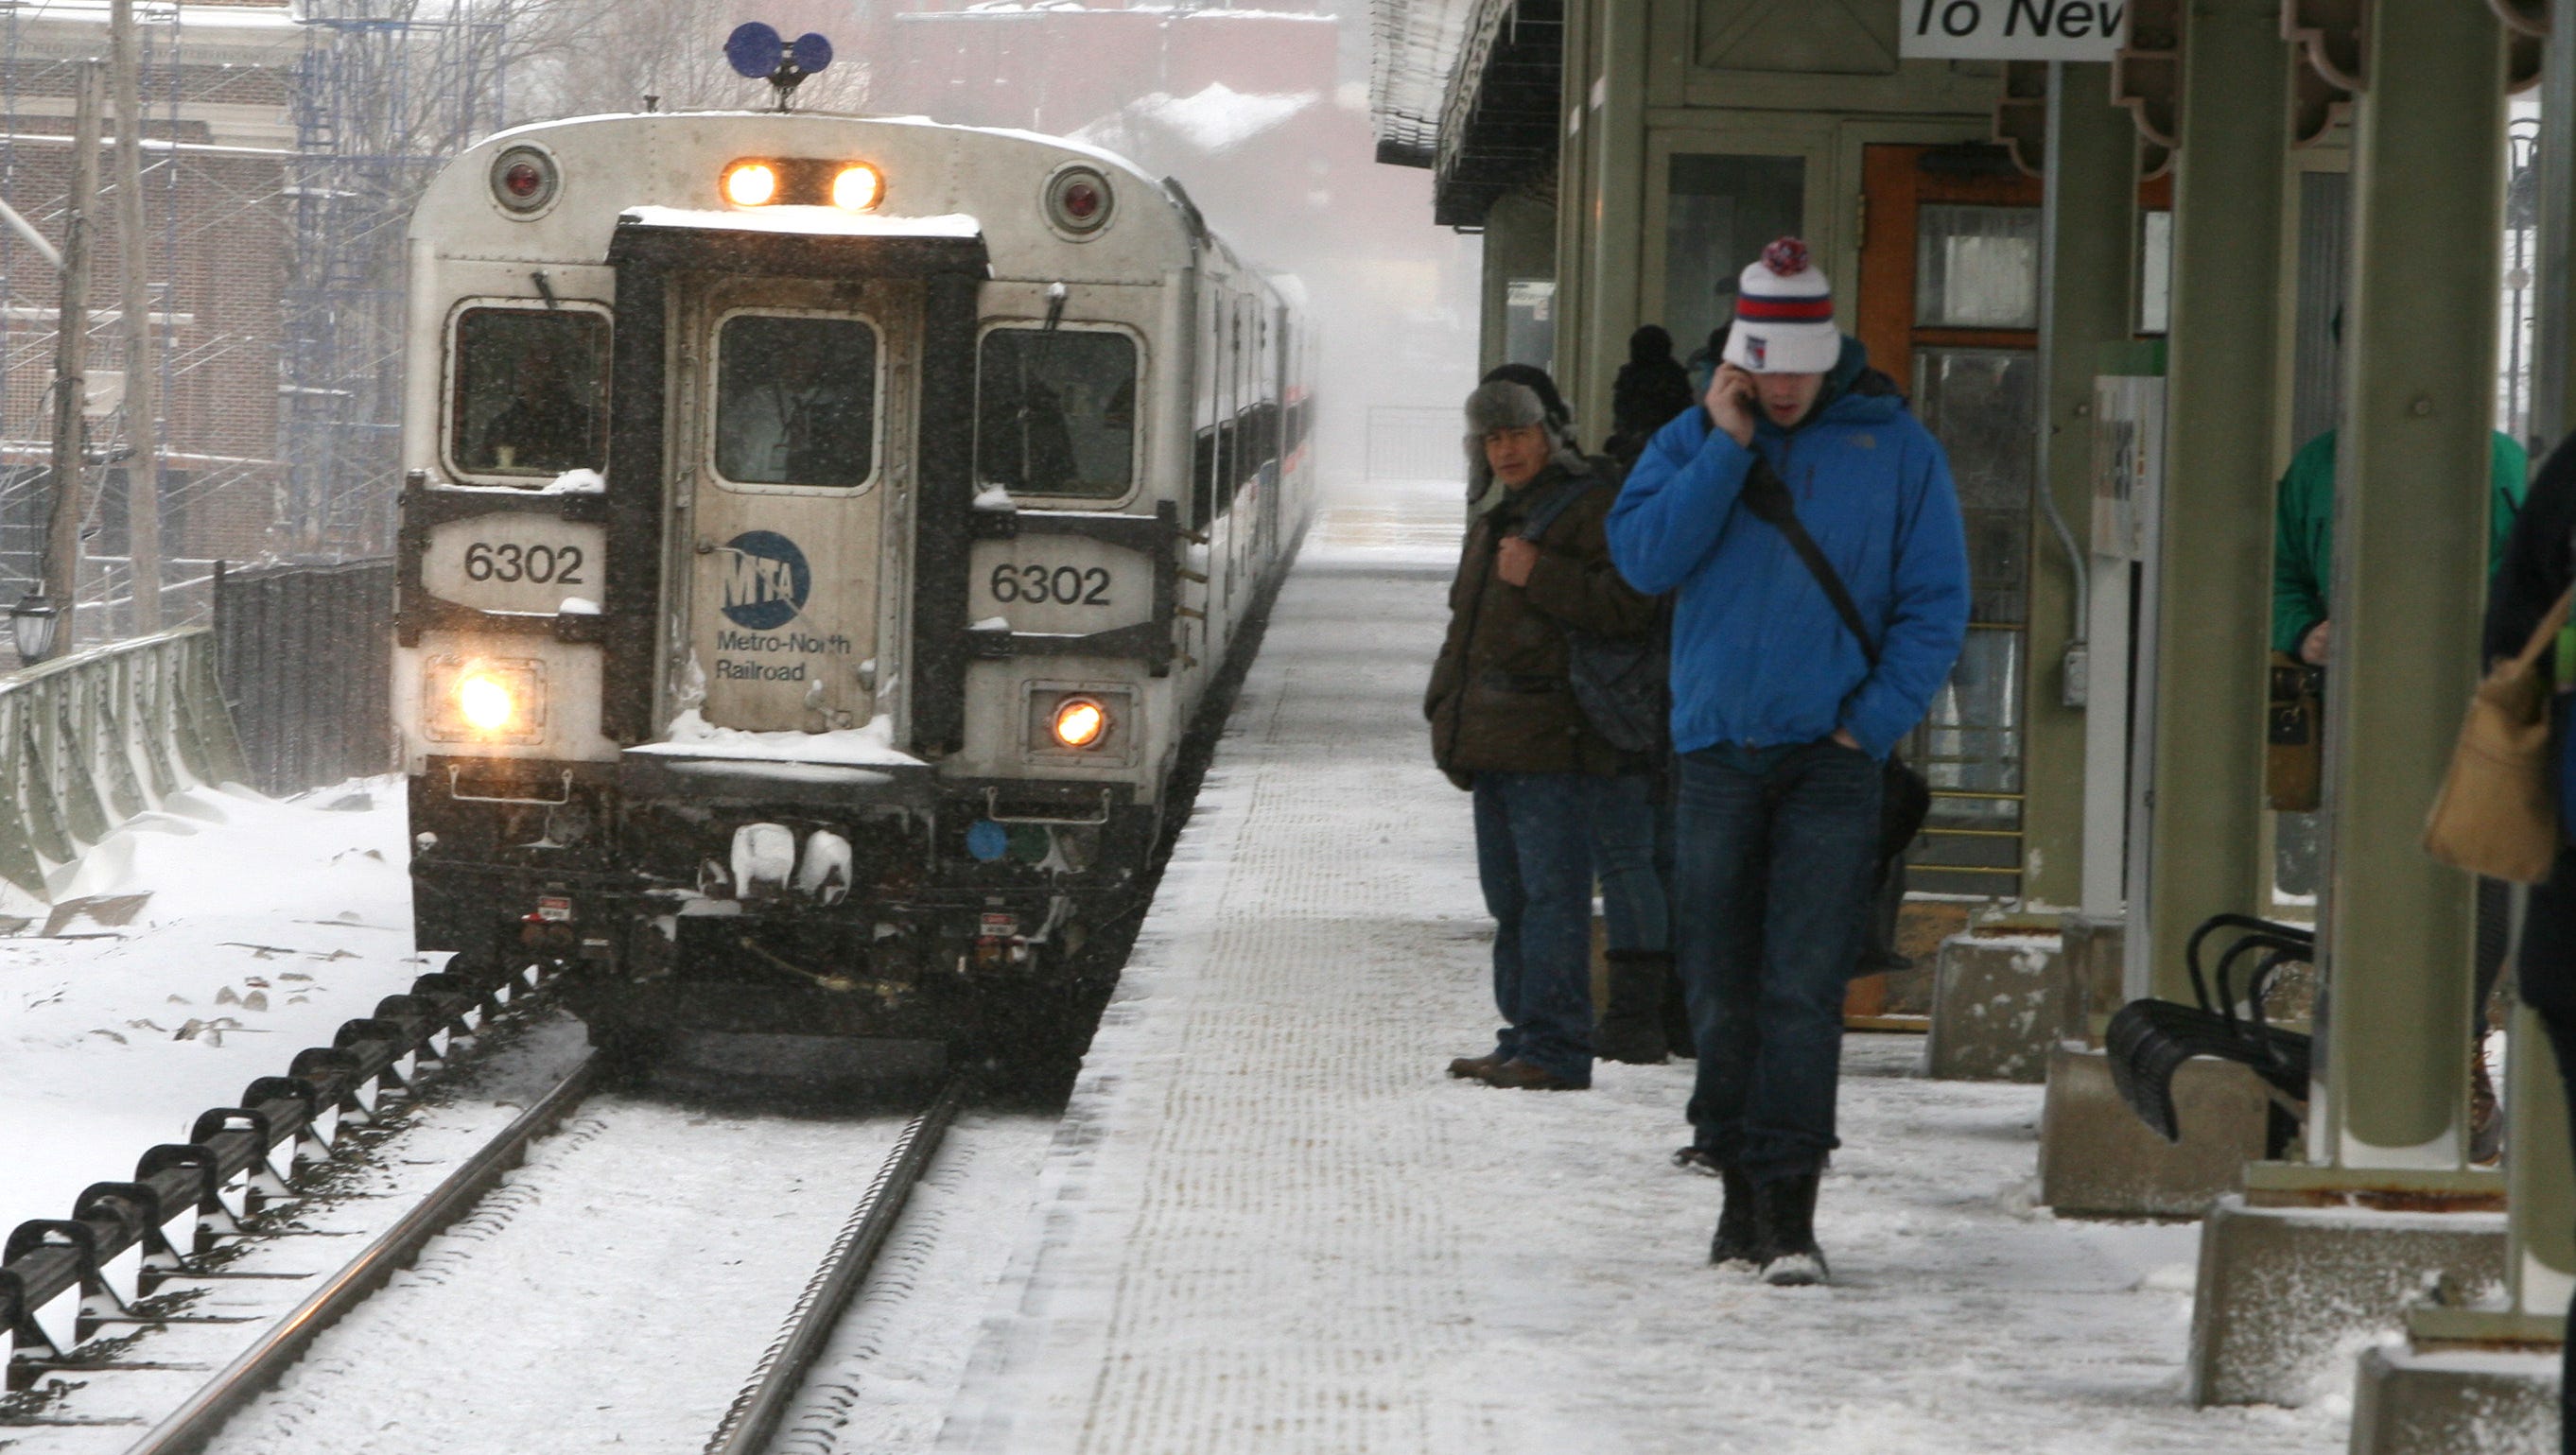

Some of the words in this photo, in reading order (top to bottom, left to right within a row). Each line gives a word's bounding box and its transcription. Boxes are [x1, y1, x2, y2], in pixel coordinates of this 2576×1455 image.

[464, 542, 583, 584] 6302
[719, 549, 794, 608] MTA
[991, 563, 1112, 606] 6302
[717, 631, 851, 654] Metro-North
[716, 659, 807, 682] Railroad
